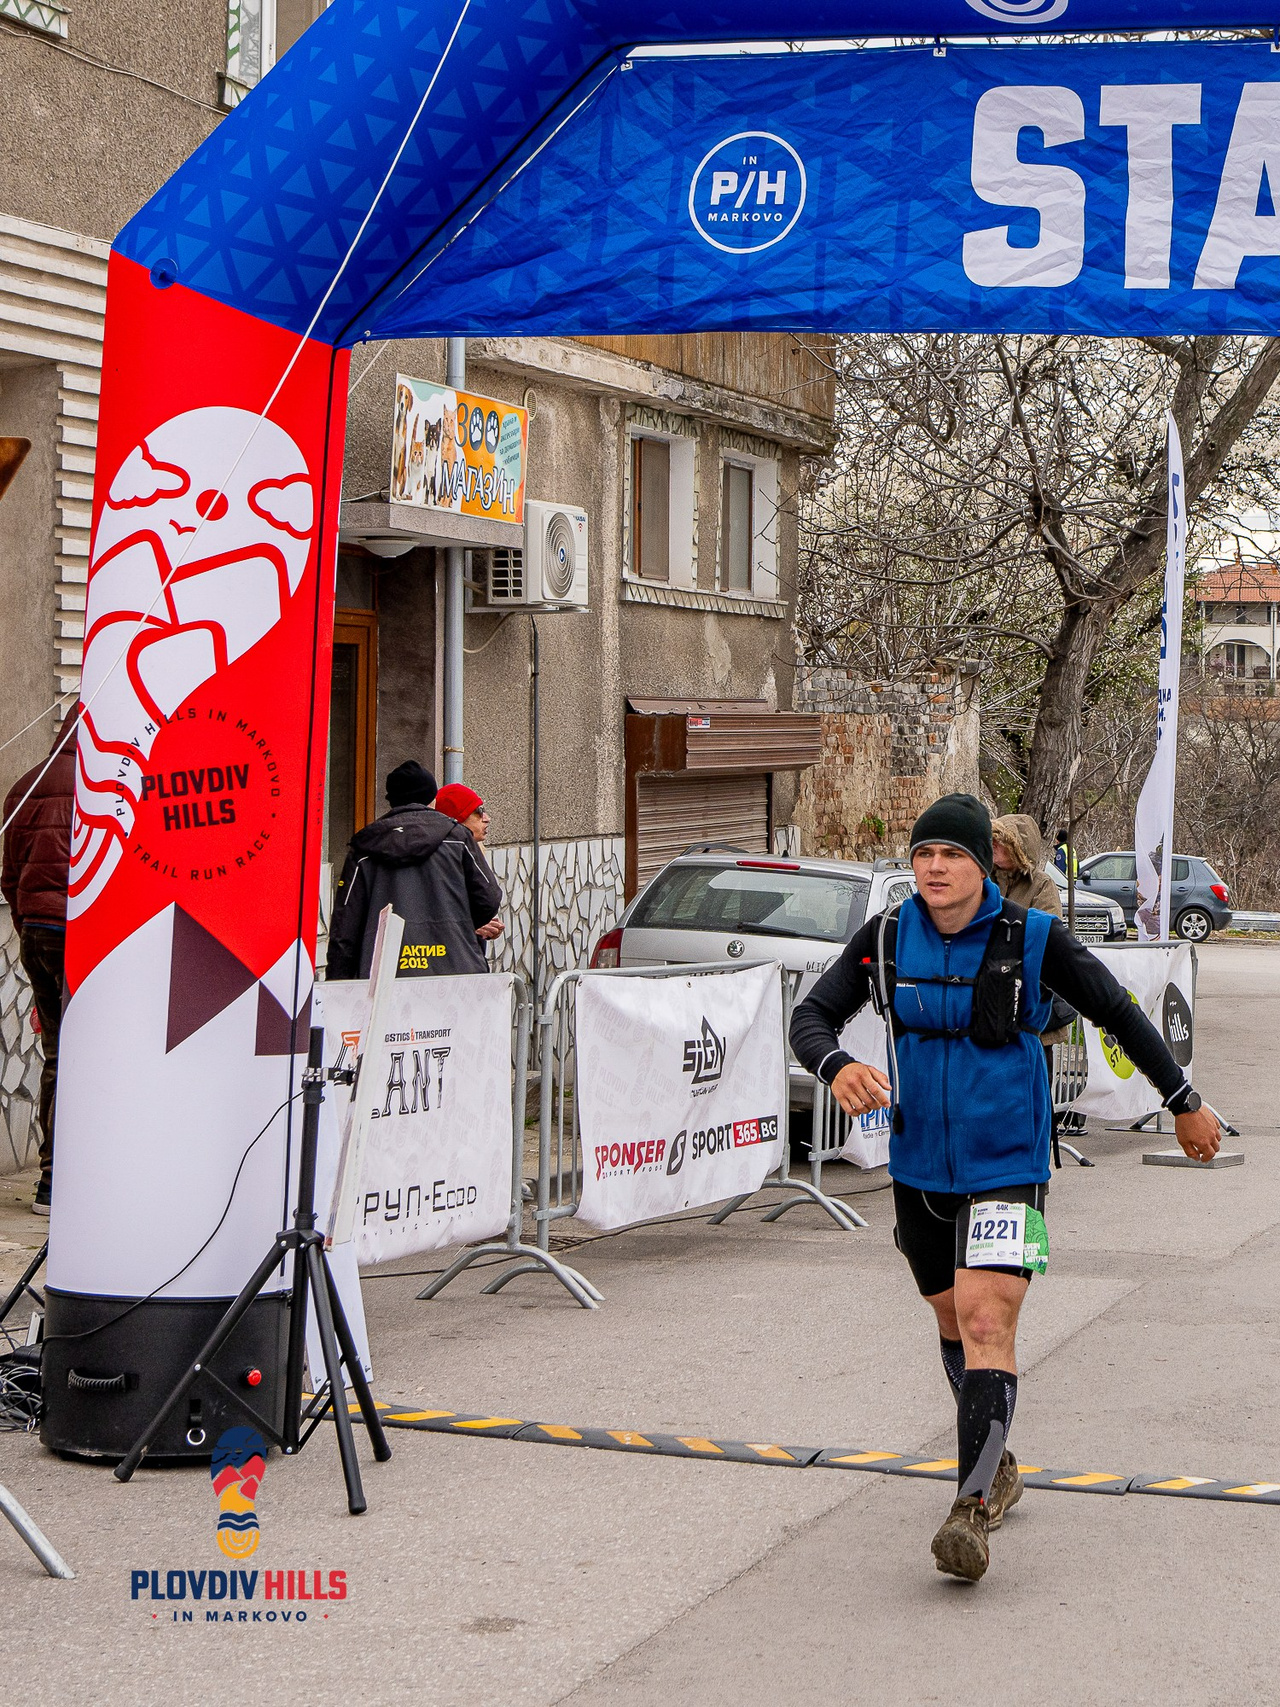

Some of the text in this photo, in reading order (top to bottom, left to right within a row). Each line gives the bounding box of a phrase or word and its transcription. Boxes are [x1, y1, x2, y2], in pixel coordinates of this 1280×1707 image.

[742, 156, 757, 165] IN
[710, 170, 787, 208] P/H
[708, 213, 783, 222] MARKOVO
[441, 458, 515, 514] МАГАЗИН
[115, 737, 141, 816] PLOVDIV
[145, 708, 197, 735] HILLS
[208, 709, 228, 722] IN
[236, 719, 280, 797] MARKOVO
[141, 764, 249, 801] PLOVDIV
[163, 799, 236, 831] HILLS
[133, 830, 270, 880] TRAIL RUN RACE
[399, 957, 429, 969] 2013
[402, 945, 447, 957] АКТИВ
[415, 1028, 451, 1040] TRANSPORT
[1168, 1013, 1189, 1042] hills
[371, 1046, 451, 1119] ANT
[594, 1138, 666, 1181] SPONSER
[971, 1219, 1018, 1241] 4221
